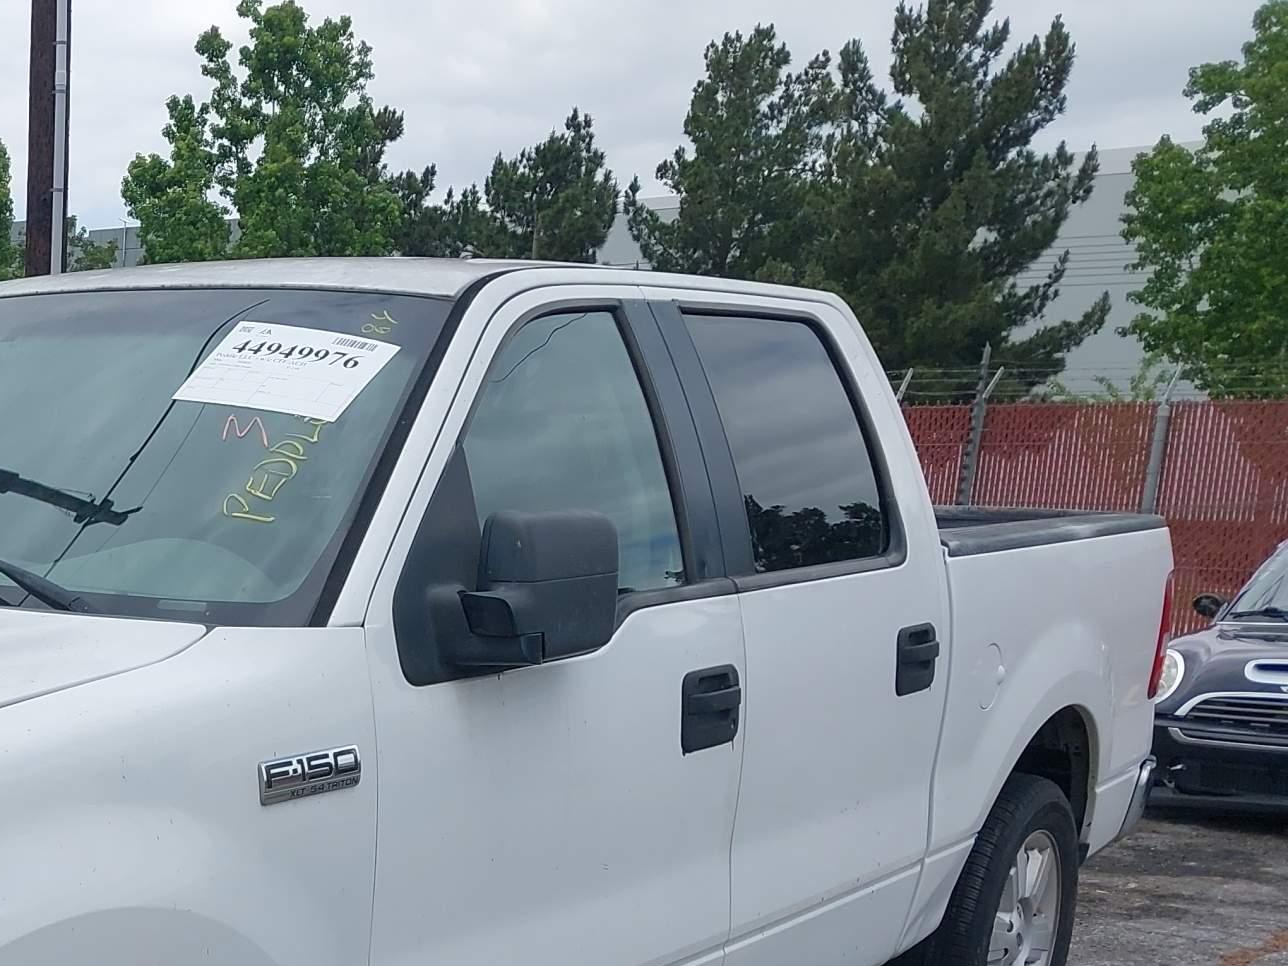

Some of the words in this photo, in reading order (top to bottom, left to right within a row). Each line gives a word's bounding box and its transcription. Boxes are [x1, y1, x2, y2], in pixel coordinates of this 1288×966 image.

[231, 339, 364, 369] 44949976
[223, 417, 326, 522] PEDDL
[265, 748, 359, 789] F-150
